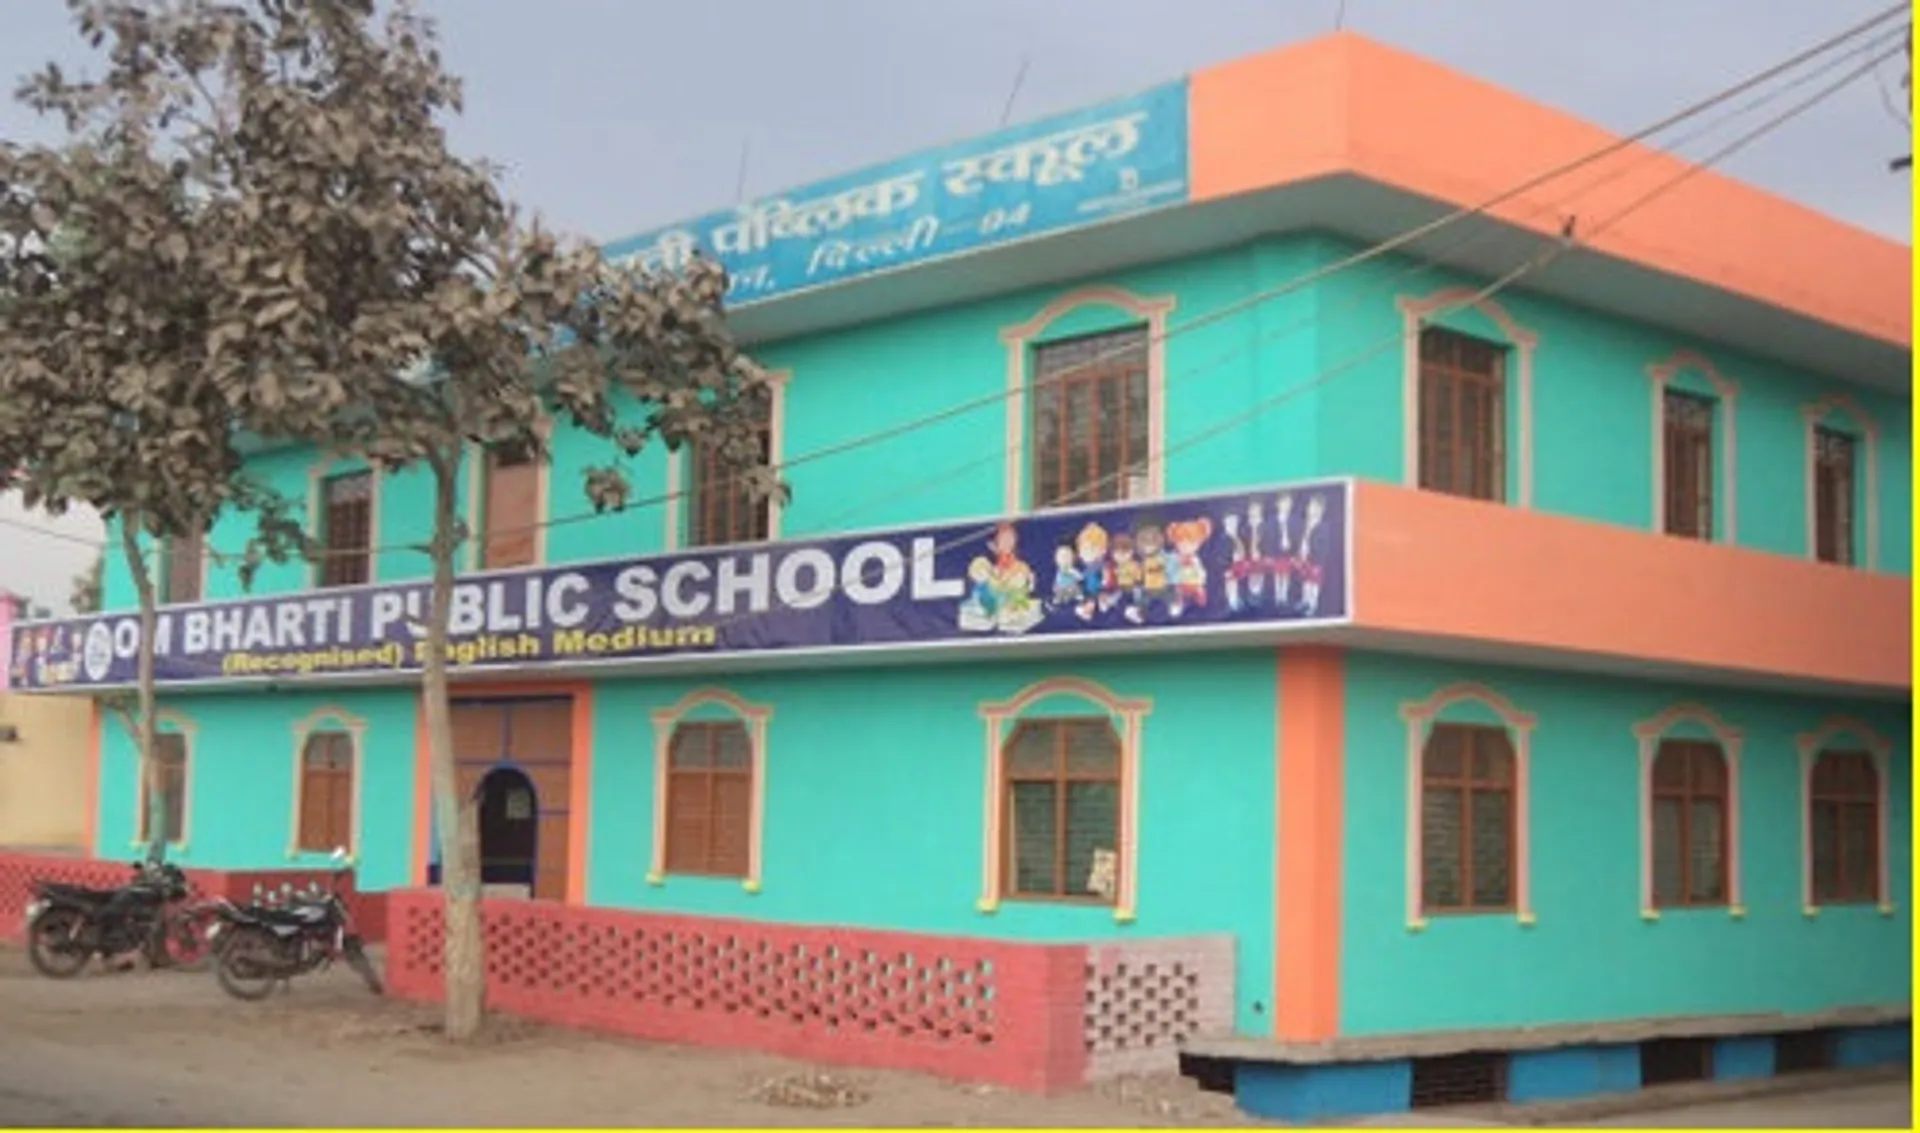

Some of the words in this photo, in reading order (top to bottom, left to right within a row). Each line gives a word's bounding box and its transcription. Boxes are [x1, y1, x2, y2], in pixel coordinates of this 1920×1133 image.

[942, 111, 1148, 196] स्कूल
[183, 598, 352, 655] BHARTI
[613, 537, 967, 623] SCHOOL
[222, 642, 404, 676] (Recognised)
[552, 624, 718, 655] Medium
